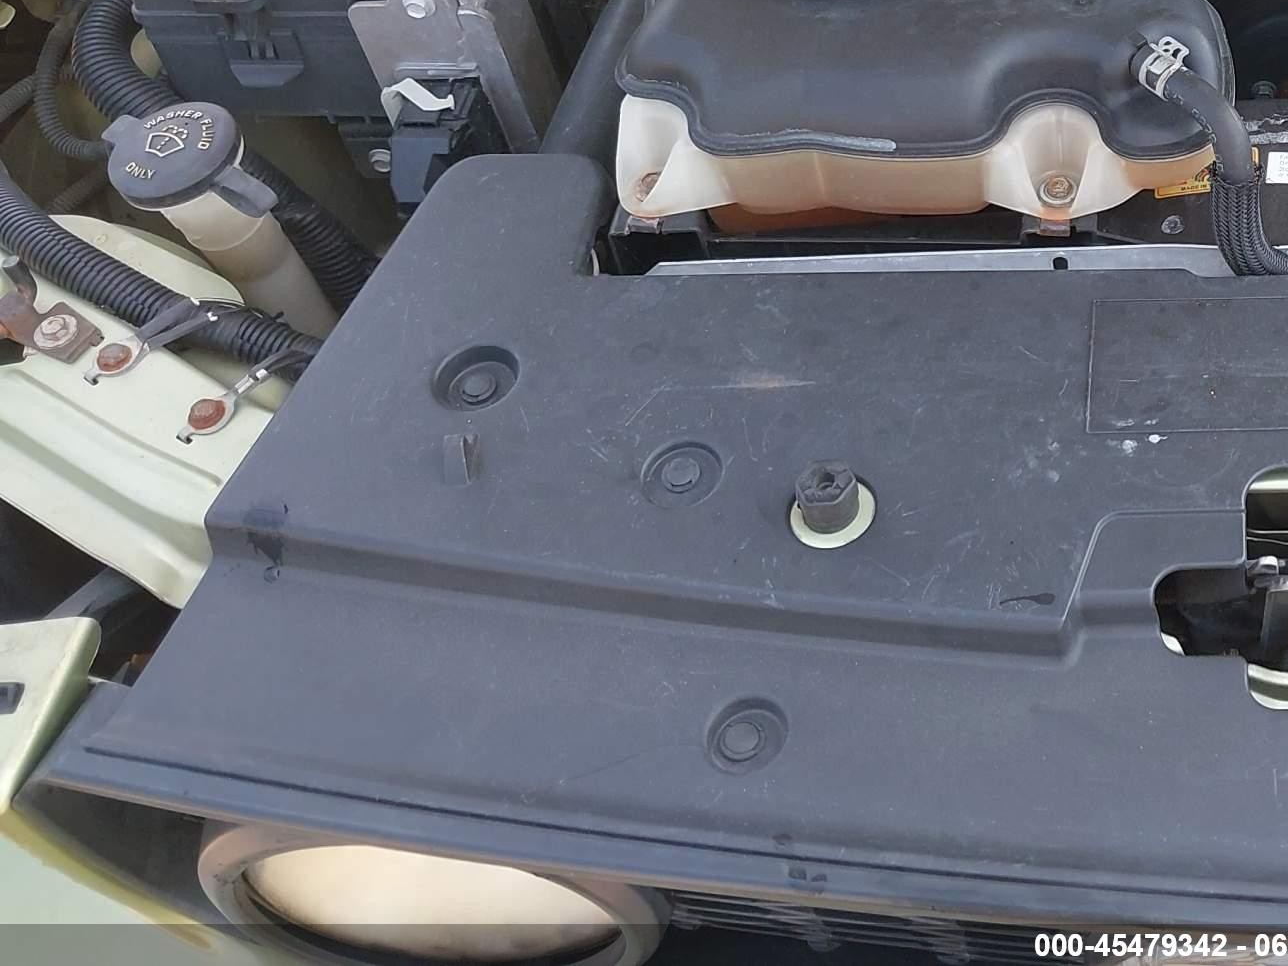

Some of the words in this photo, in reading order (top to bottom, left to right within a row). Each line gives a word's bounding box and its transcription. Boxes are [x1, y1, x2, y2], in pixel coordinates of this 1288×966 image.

[143, 109, 204, 130] WASHER
[197, 118, 215, 151] FLUID
[125, 161, 156, 180] ONLY
